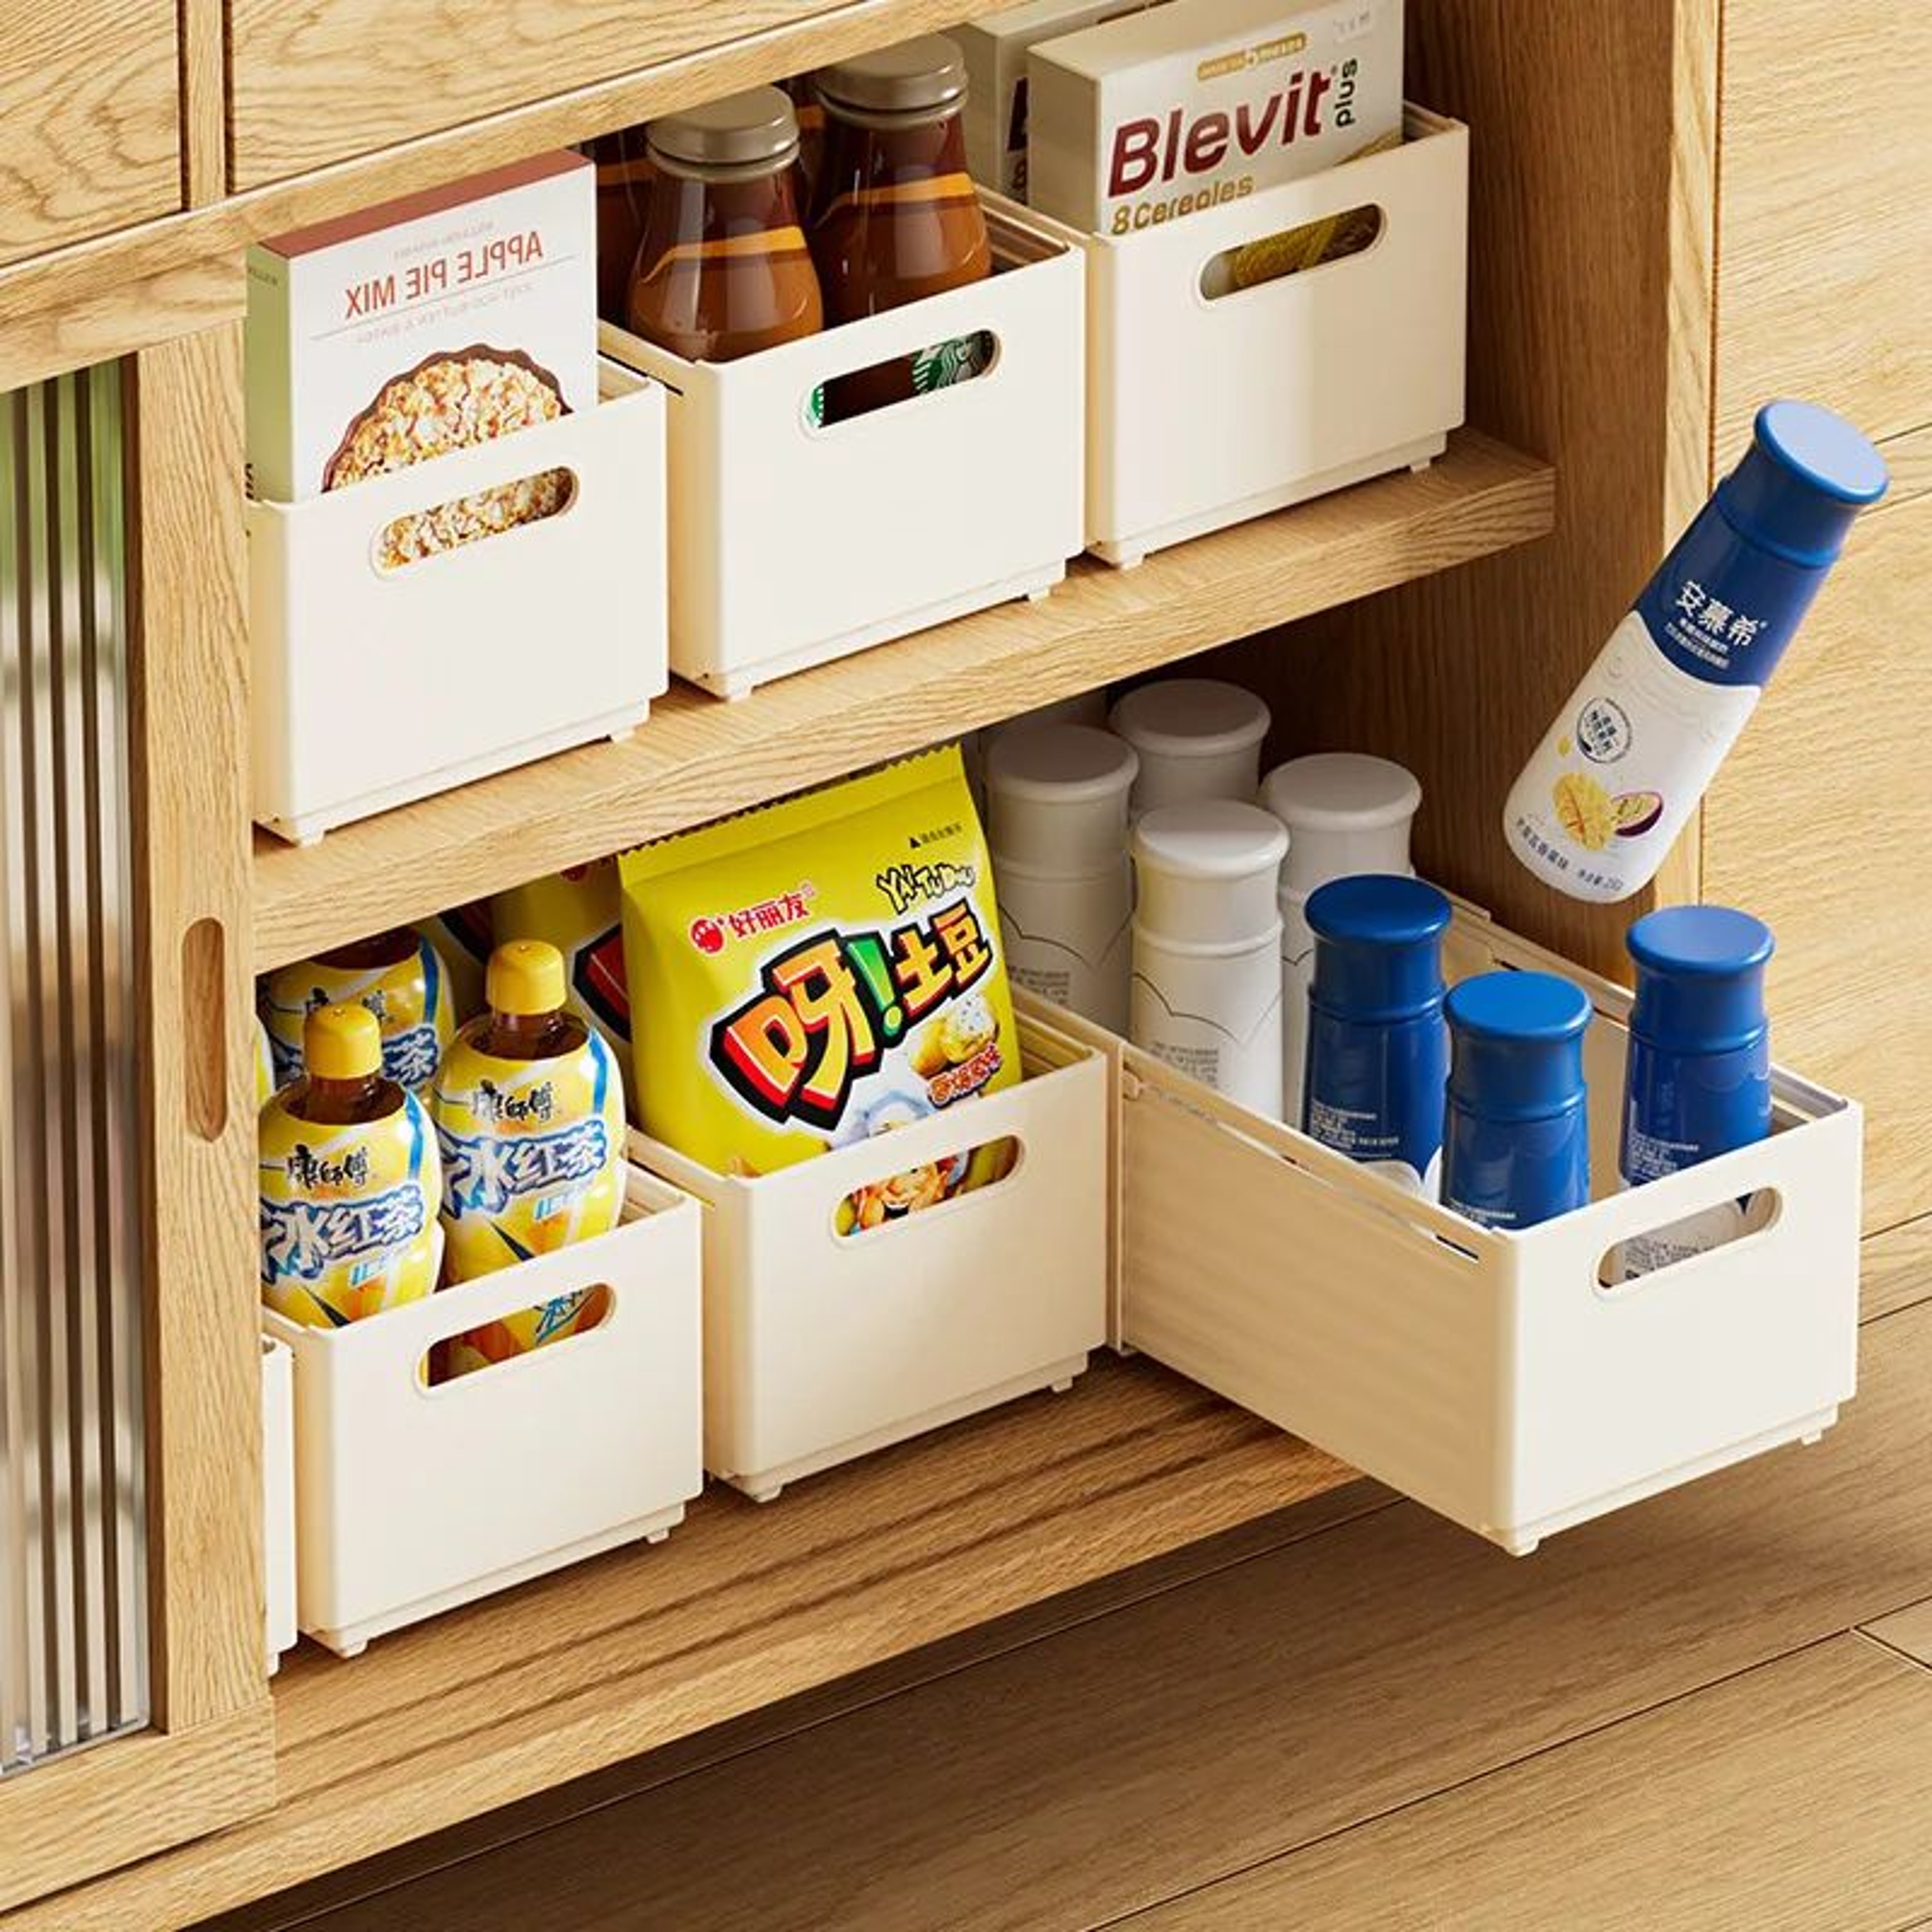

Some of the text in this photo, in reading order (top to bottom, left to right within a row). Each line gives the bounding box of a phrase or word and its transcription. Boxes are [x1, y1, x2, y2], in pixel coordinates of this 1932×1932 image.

[1335, 58, 1358, 128] plus
[1108, 71, 1331, 199] Blevit
[1675, 581, 1759, 646] 安慕希
[729, 892, 809, 938] 好丽友
